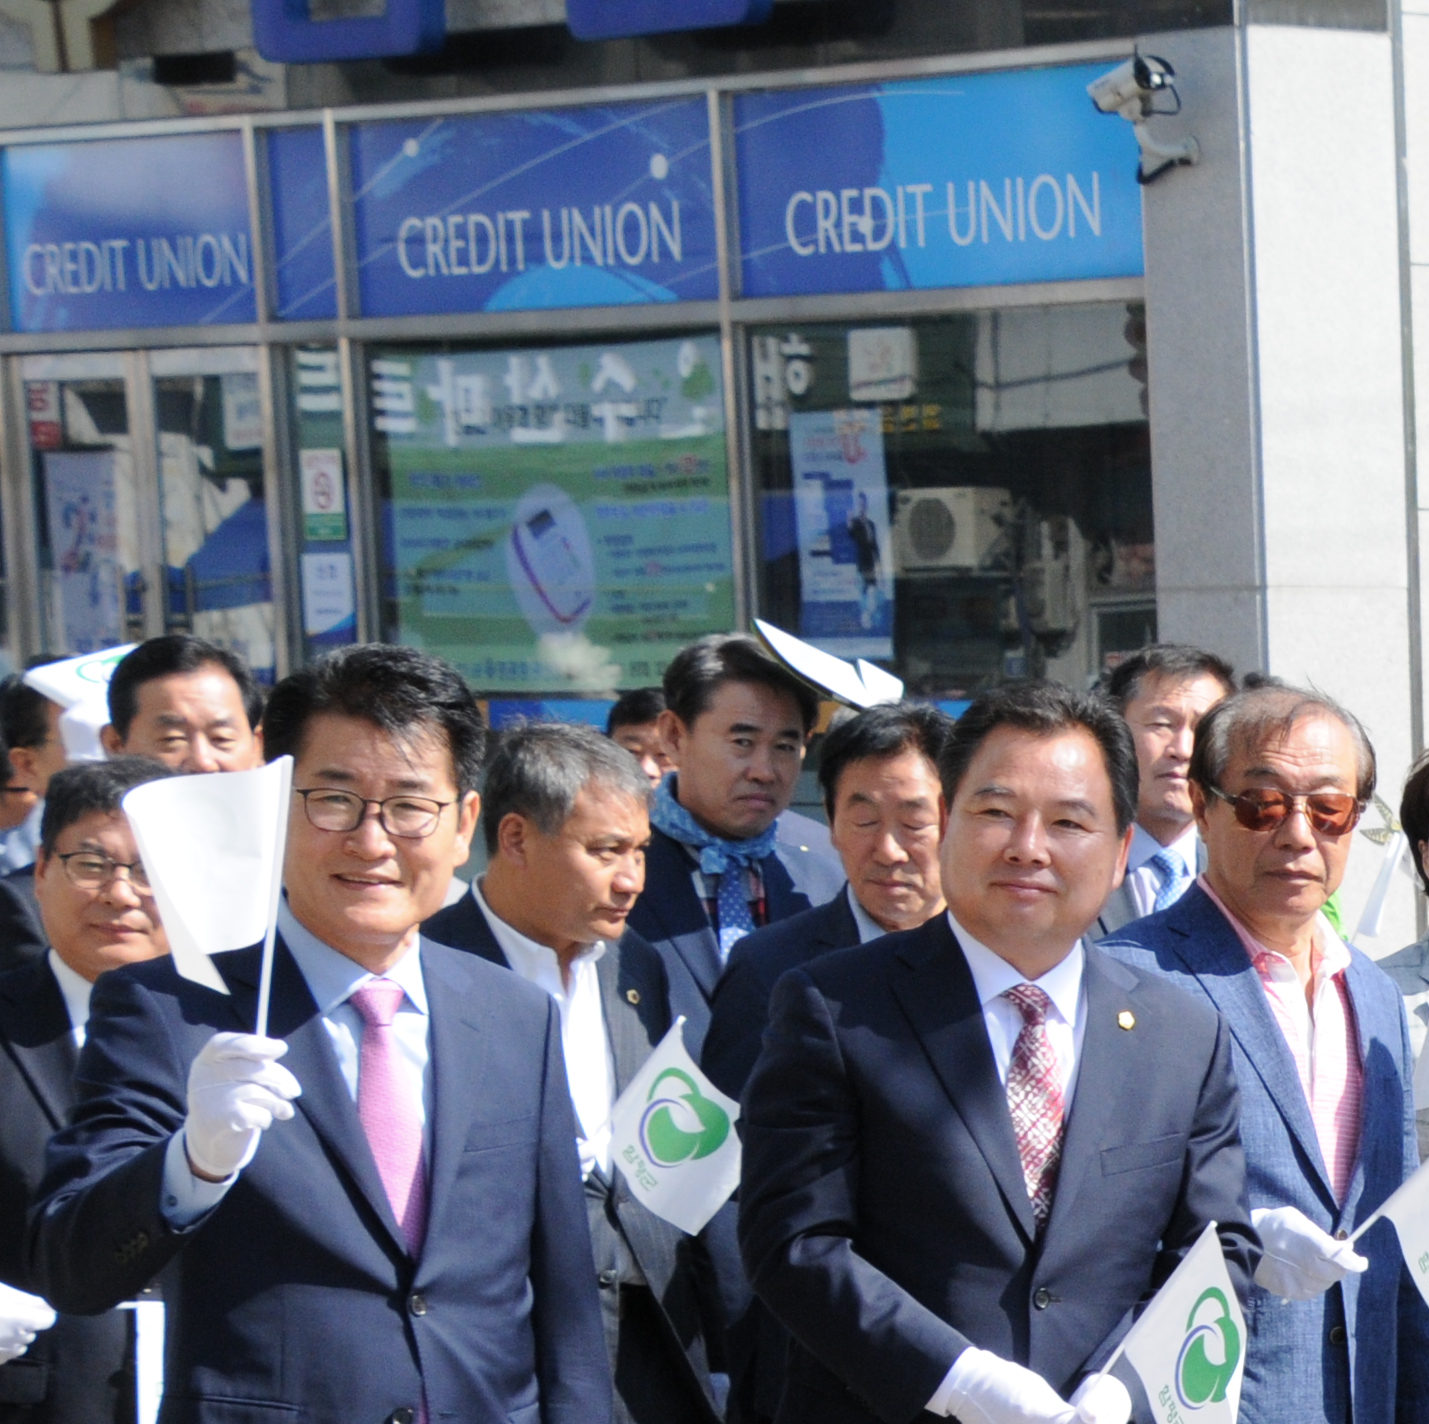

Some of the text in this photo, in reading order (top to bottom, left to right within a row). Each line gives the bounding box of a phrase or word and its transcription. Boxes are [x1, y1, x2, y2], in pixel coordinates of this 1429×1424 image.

[396, 200, 683, 279] CREDIT UNION
[784, 170, 1102, 257] CREDIT UNION
[24, 232, 251, 296] CREDIT UNION
[622, 1144, 659, 1192] 함평군
